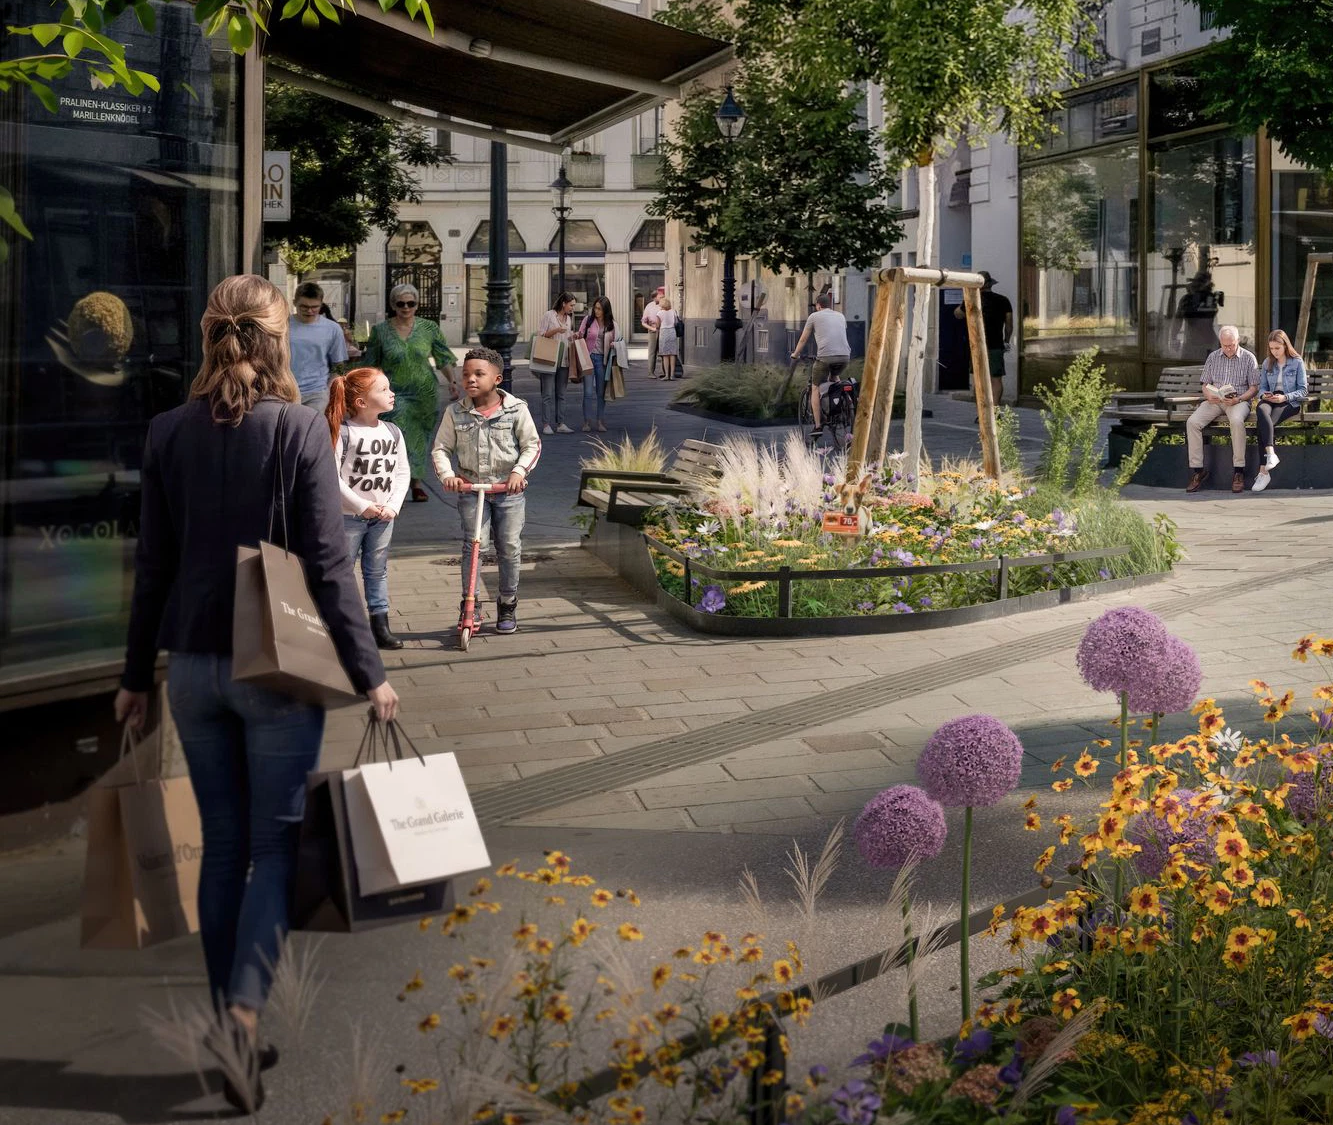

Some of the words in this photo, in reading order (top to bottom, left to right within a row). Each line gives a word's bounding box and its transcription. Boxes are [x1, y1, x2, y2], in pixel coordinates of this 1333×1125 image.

[60, 97, 140, 112] PRALINEN-KLASSIKER
[73, 110, 139, 124] MARILLENKNÖDEL
[356, 438, 397, 455] LOVE
[352, 457, 396, 475] NEW
[348, 475, 392, 492] YORK
[281, 601, 296, 616] The
[390, 818, 406, 831] The
[407, 813, 433, 828] Grand
[434, 809, 464, 823] Galerie
